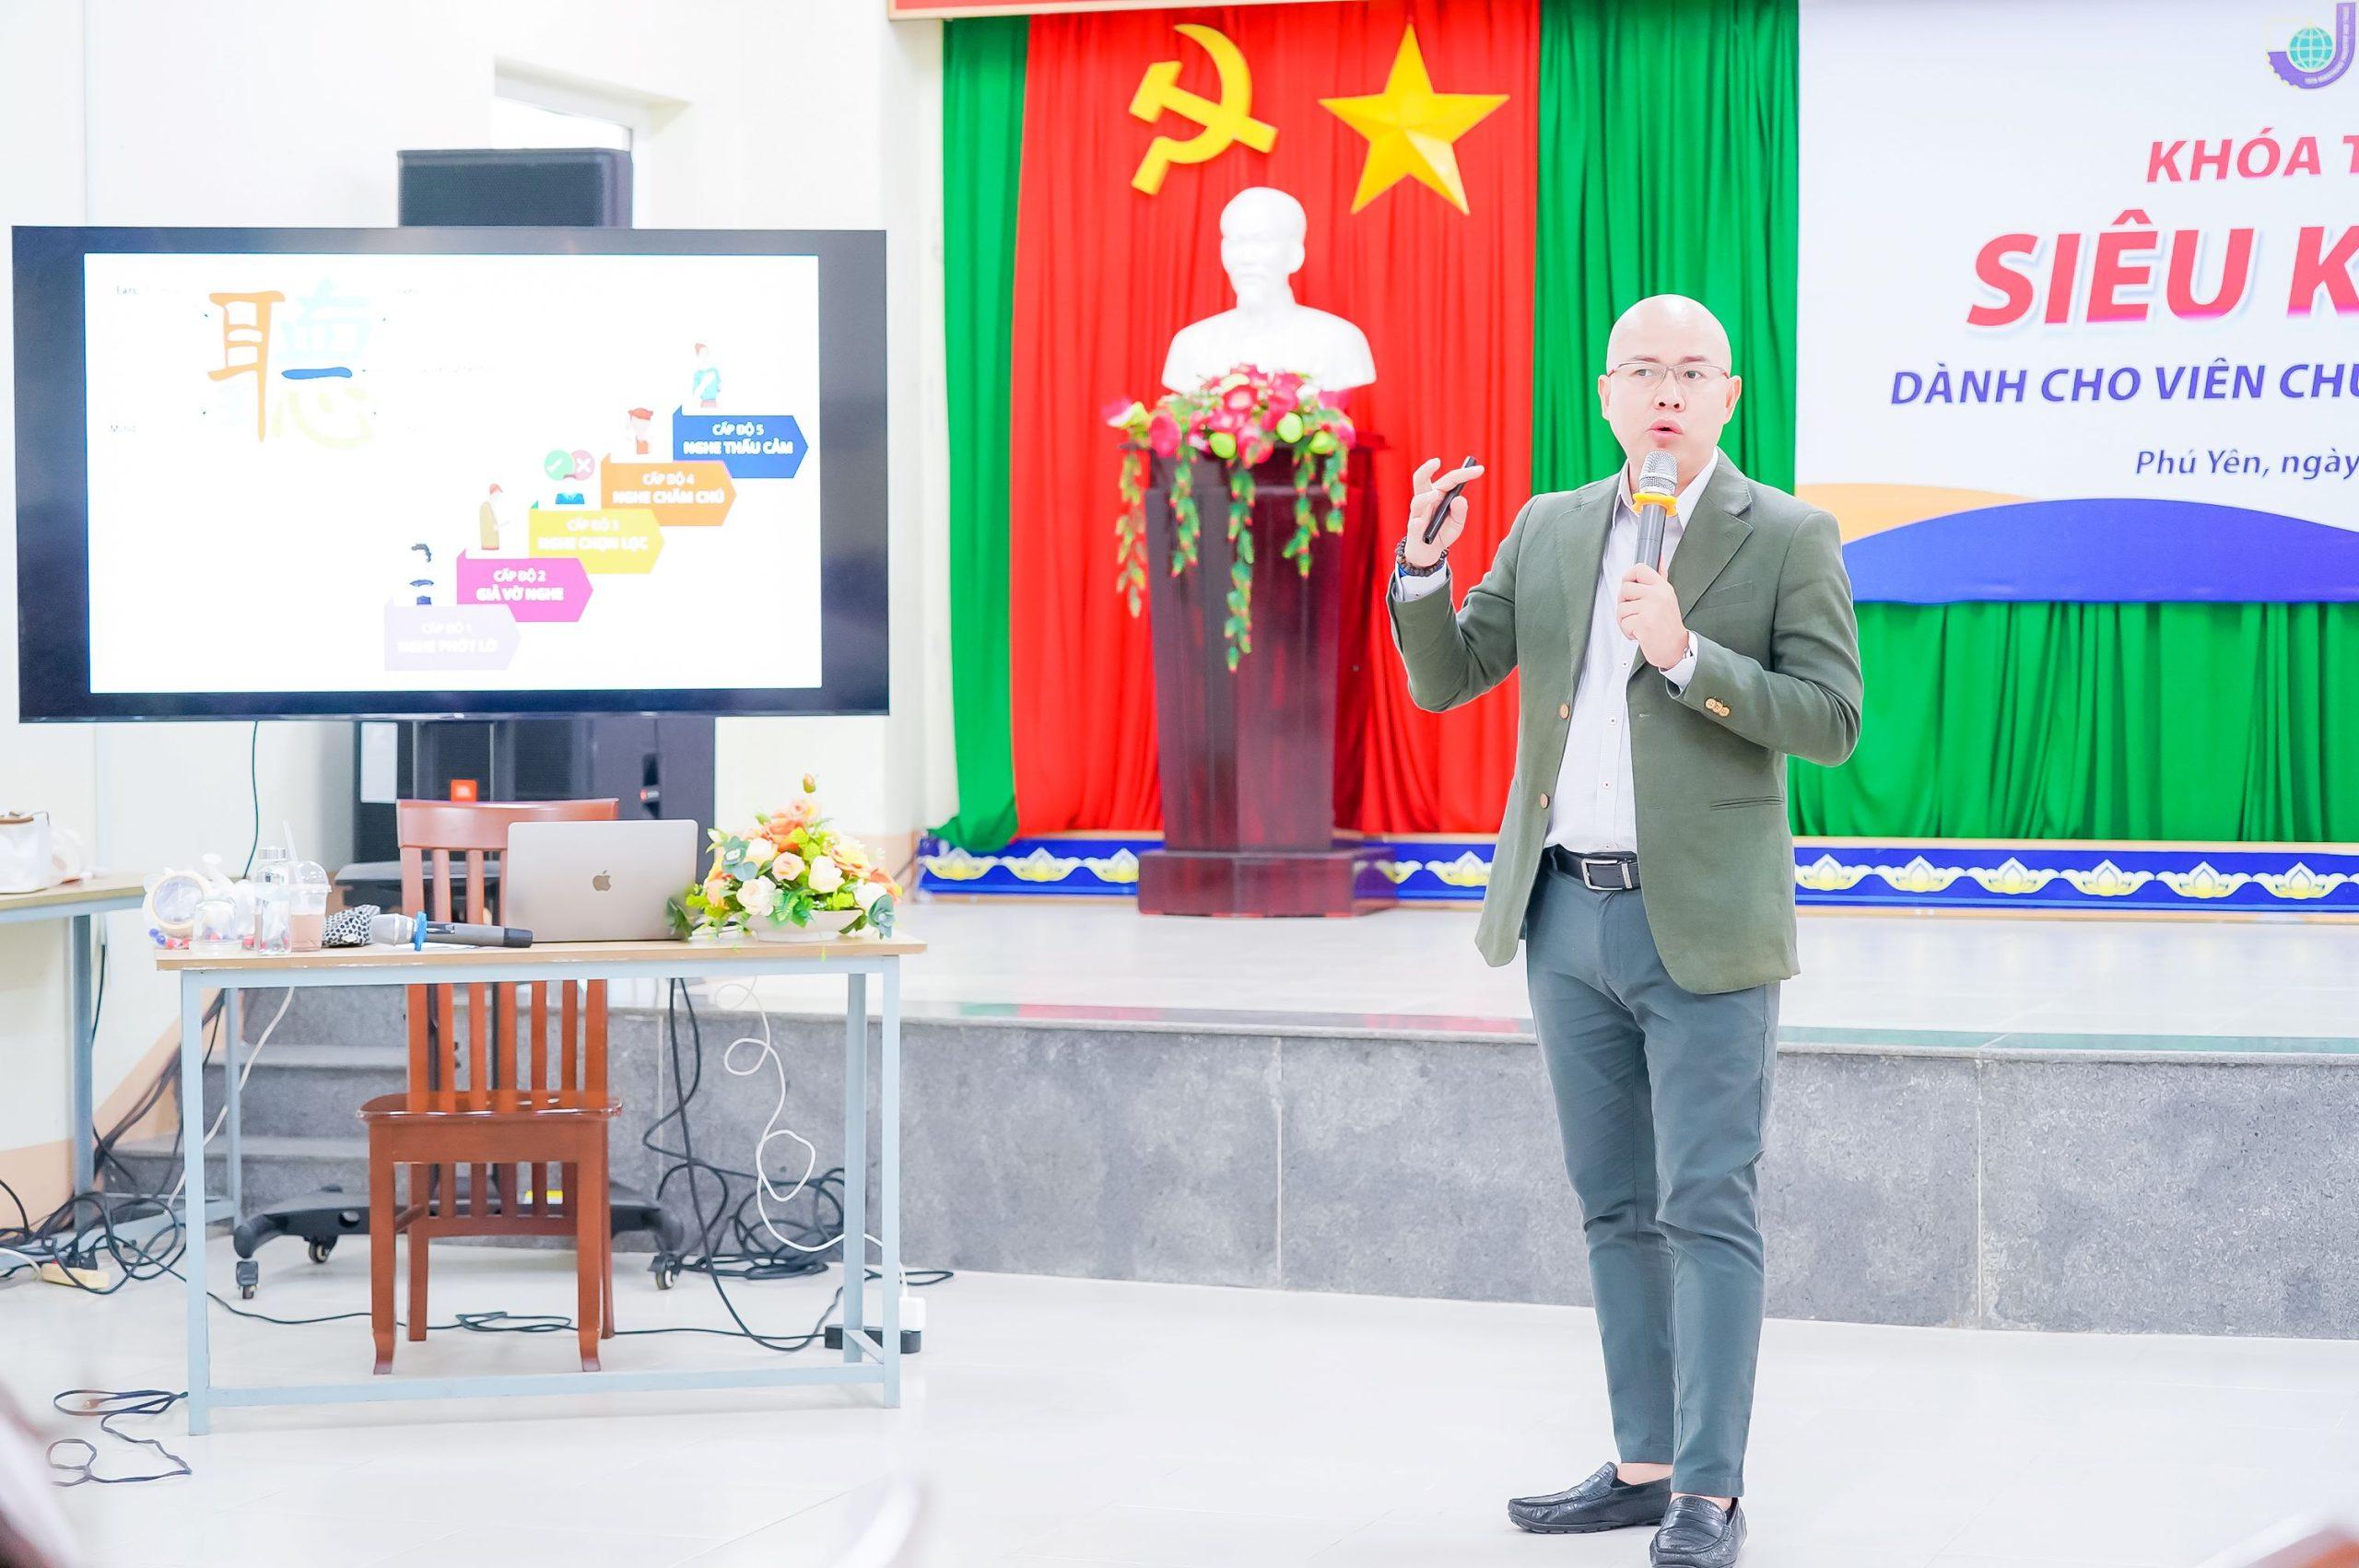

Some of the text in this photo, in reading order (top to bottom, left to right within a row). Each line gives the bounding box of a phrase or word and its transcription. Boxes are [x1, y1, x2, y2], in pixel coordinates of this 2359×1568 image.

[2147, 127, 2320, 182] KHÓA
[1967, 209, 2359, 327] SIÊU K
[1892, 357, 2359, 404] DÀNH CHO VIÊN CH
[757, 424, 764, 435] 5
[683, 441, 722, 454] NGHE
[2136, 448, 2359, 480] Phú Yên, ngày
[537, 569, 546, 582] 2
